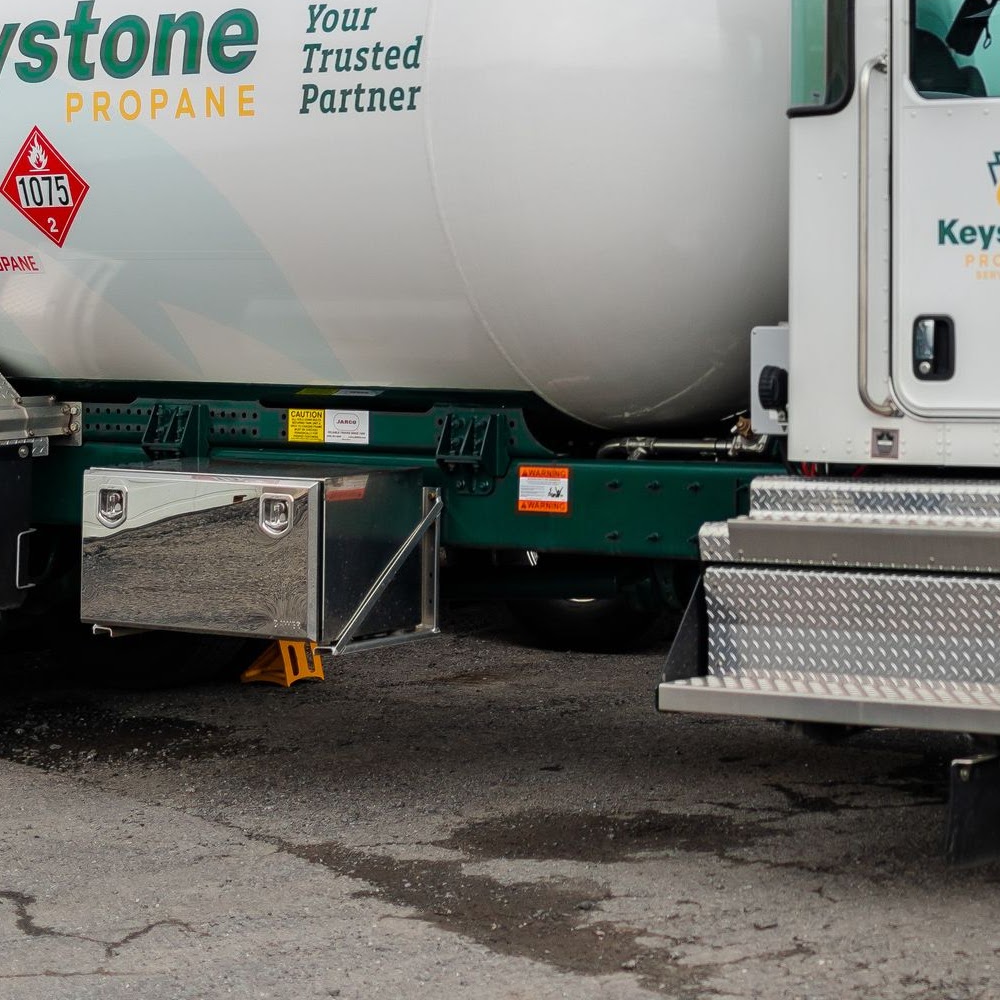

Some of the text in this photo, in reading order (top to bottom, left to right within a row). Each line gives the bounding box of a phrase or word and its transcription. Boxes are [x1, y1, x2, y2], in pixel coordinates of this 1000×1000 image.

[306, 3, 378, 33] Your
[302, 35, 424, 73] Trusted
[66, 85, 255, 123] PROPANE
[299, 83, 421, 114] Partner
[19, 176, 70, 207] 1075
[47, 217, 59, 233] 2
[291, 410, 322, 418] CAUTION
